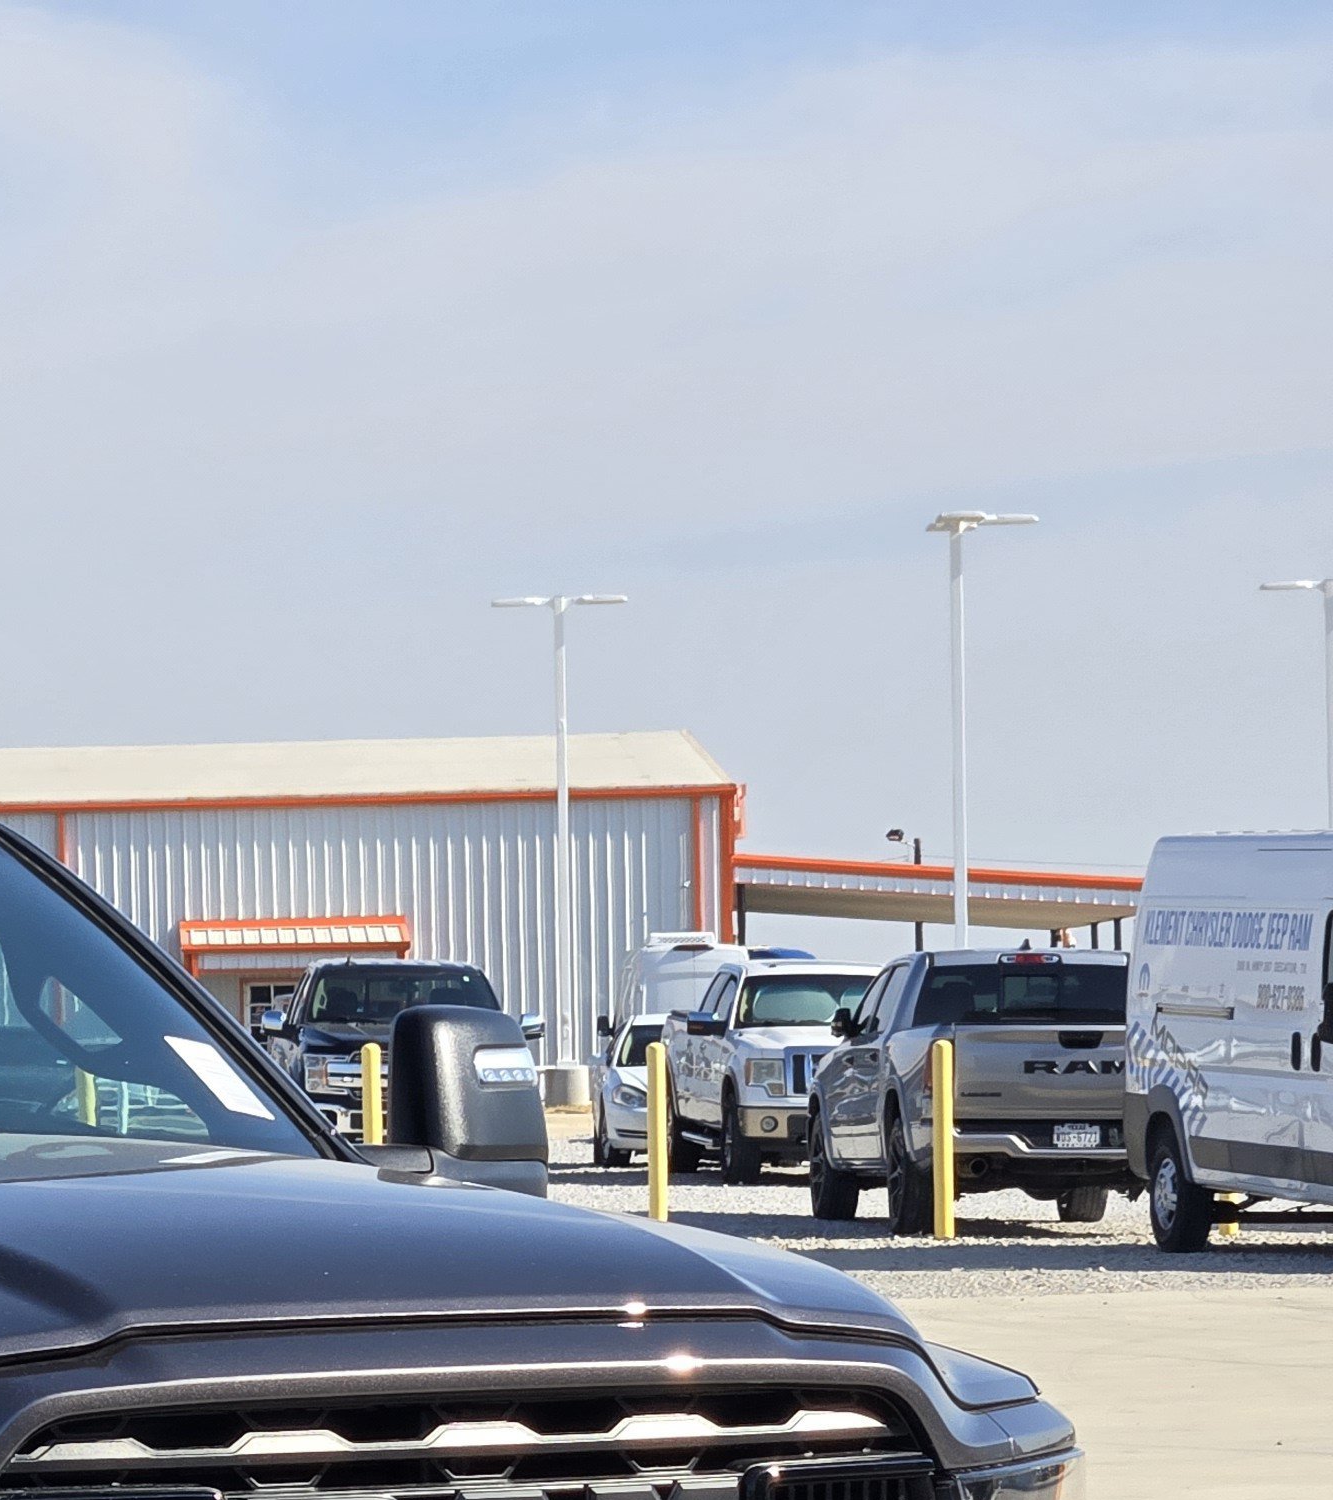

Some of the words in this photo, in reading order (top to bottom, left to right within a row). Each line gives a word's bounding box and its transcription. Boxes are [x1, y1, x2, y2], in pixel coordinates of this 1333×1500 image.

[1232, 912, 1265, 949] DODGE
[1263, 913, 1290, 949] JEEP
[1288, 914, 1314, 951] RAM
[1023, 1060, 1126, 1075] RAM
